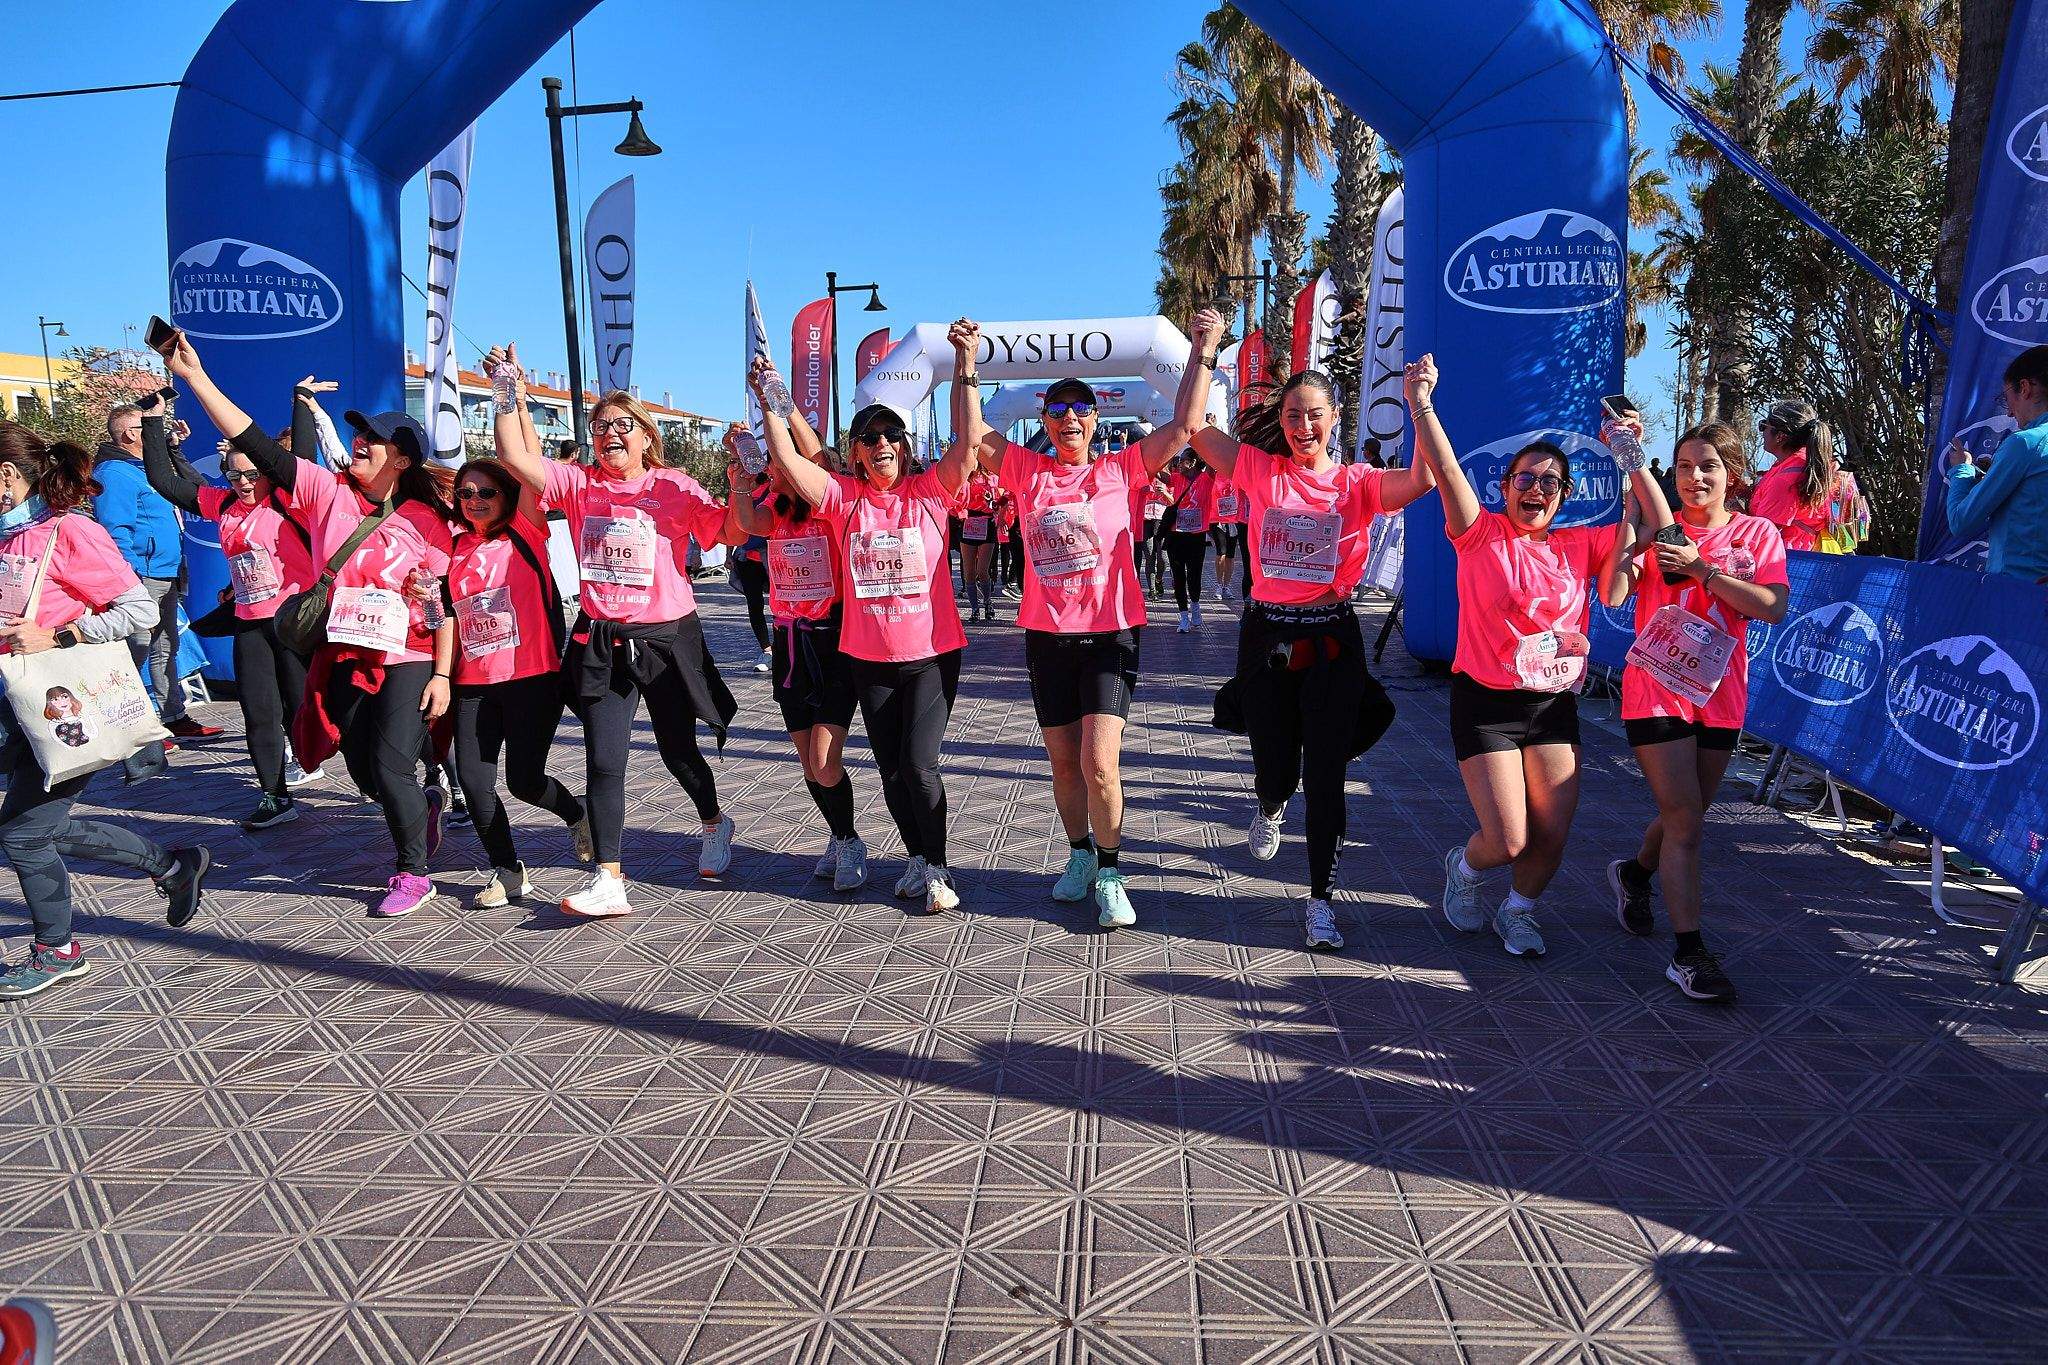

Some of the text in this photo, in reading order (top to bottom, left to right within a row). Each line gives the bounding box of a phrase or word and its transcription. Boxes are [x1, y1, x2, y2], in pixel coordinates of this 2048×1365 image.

[1490, 245, 1618, 259] CENTRAL LECHERA
[183, 273, 320, 290] CENTRAL LECHERA
[1457, 253, 1619, 294] ASTURIANA
[171, 278, 328, 320] ASTURIANA
[975, 331, 1113, 365] OYSHO
[805, 323, 821, 408] Santander
[877, 371, 921, 381] OYSHO
[1572, 461, 1613, 472] ECHERA
[1049, 534, 1075, 549] 016
[1285, 540, 1315, 555] 016
[604, 546, 632, 559] 016
[787, 566, 810, 578] 016
[876, 559, 903, 571] 016
[476, 617, 498, 633] 016
[1667, 645, 1701, 669] 016
[1776, 629, 1868, 690] ASTURIANA
[1543, 661, 1569, 678] 016
[1890, 664, 2019, 755] ASTURIANA
